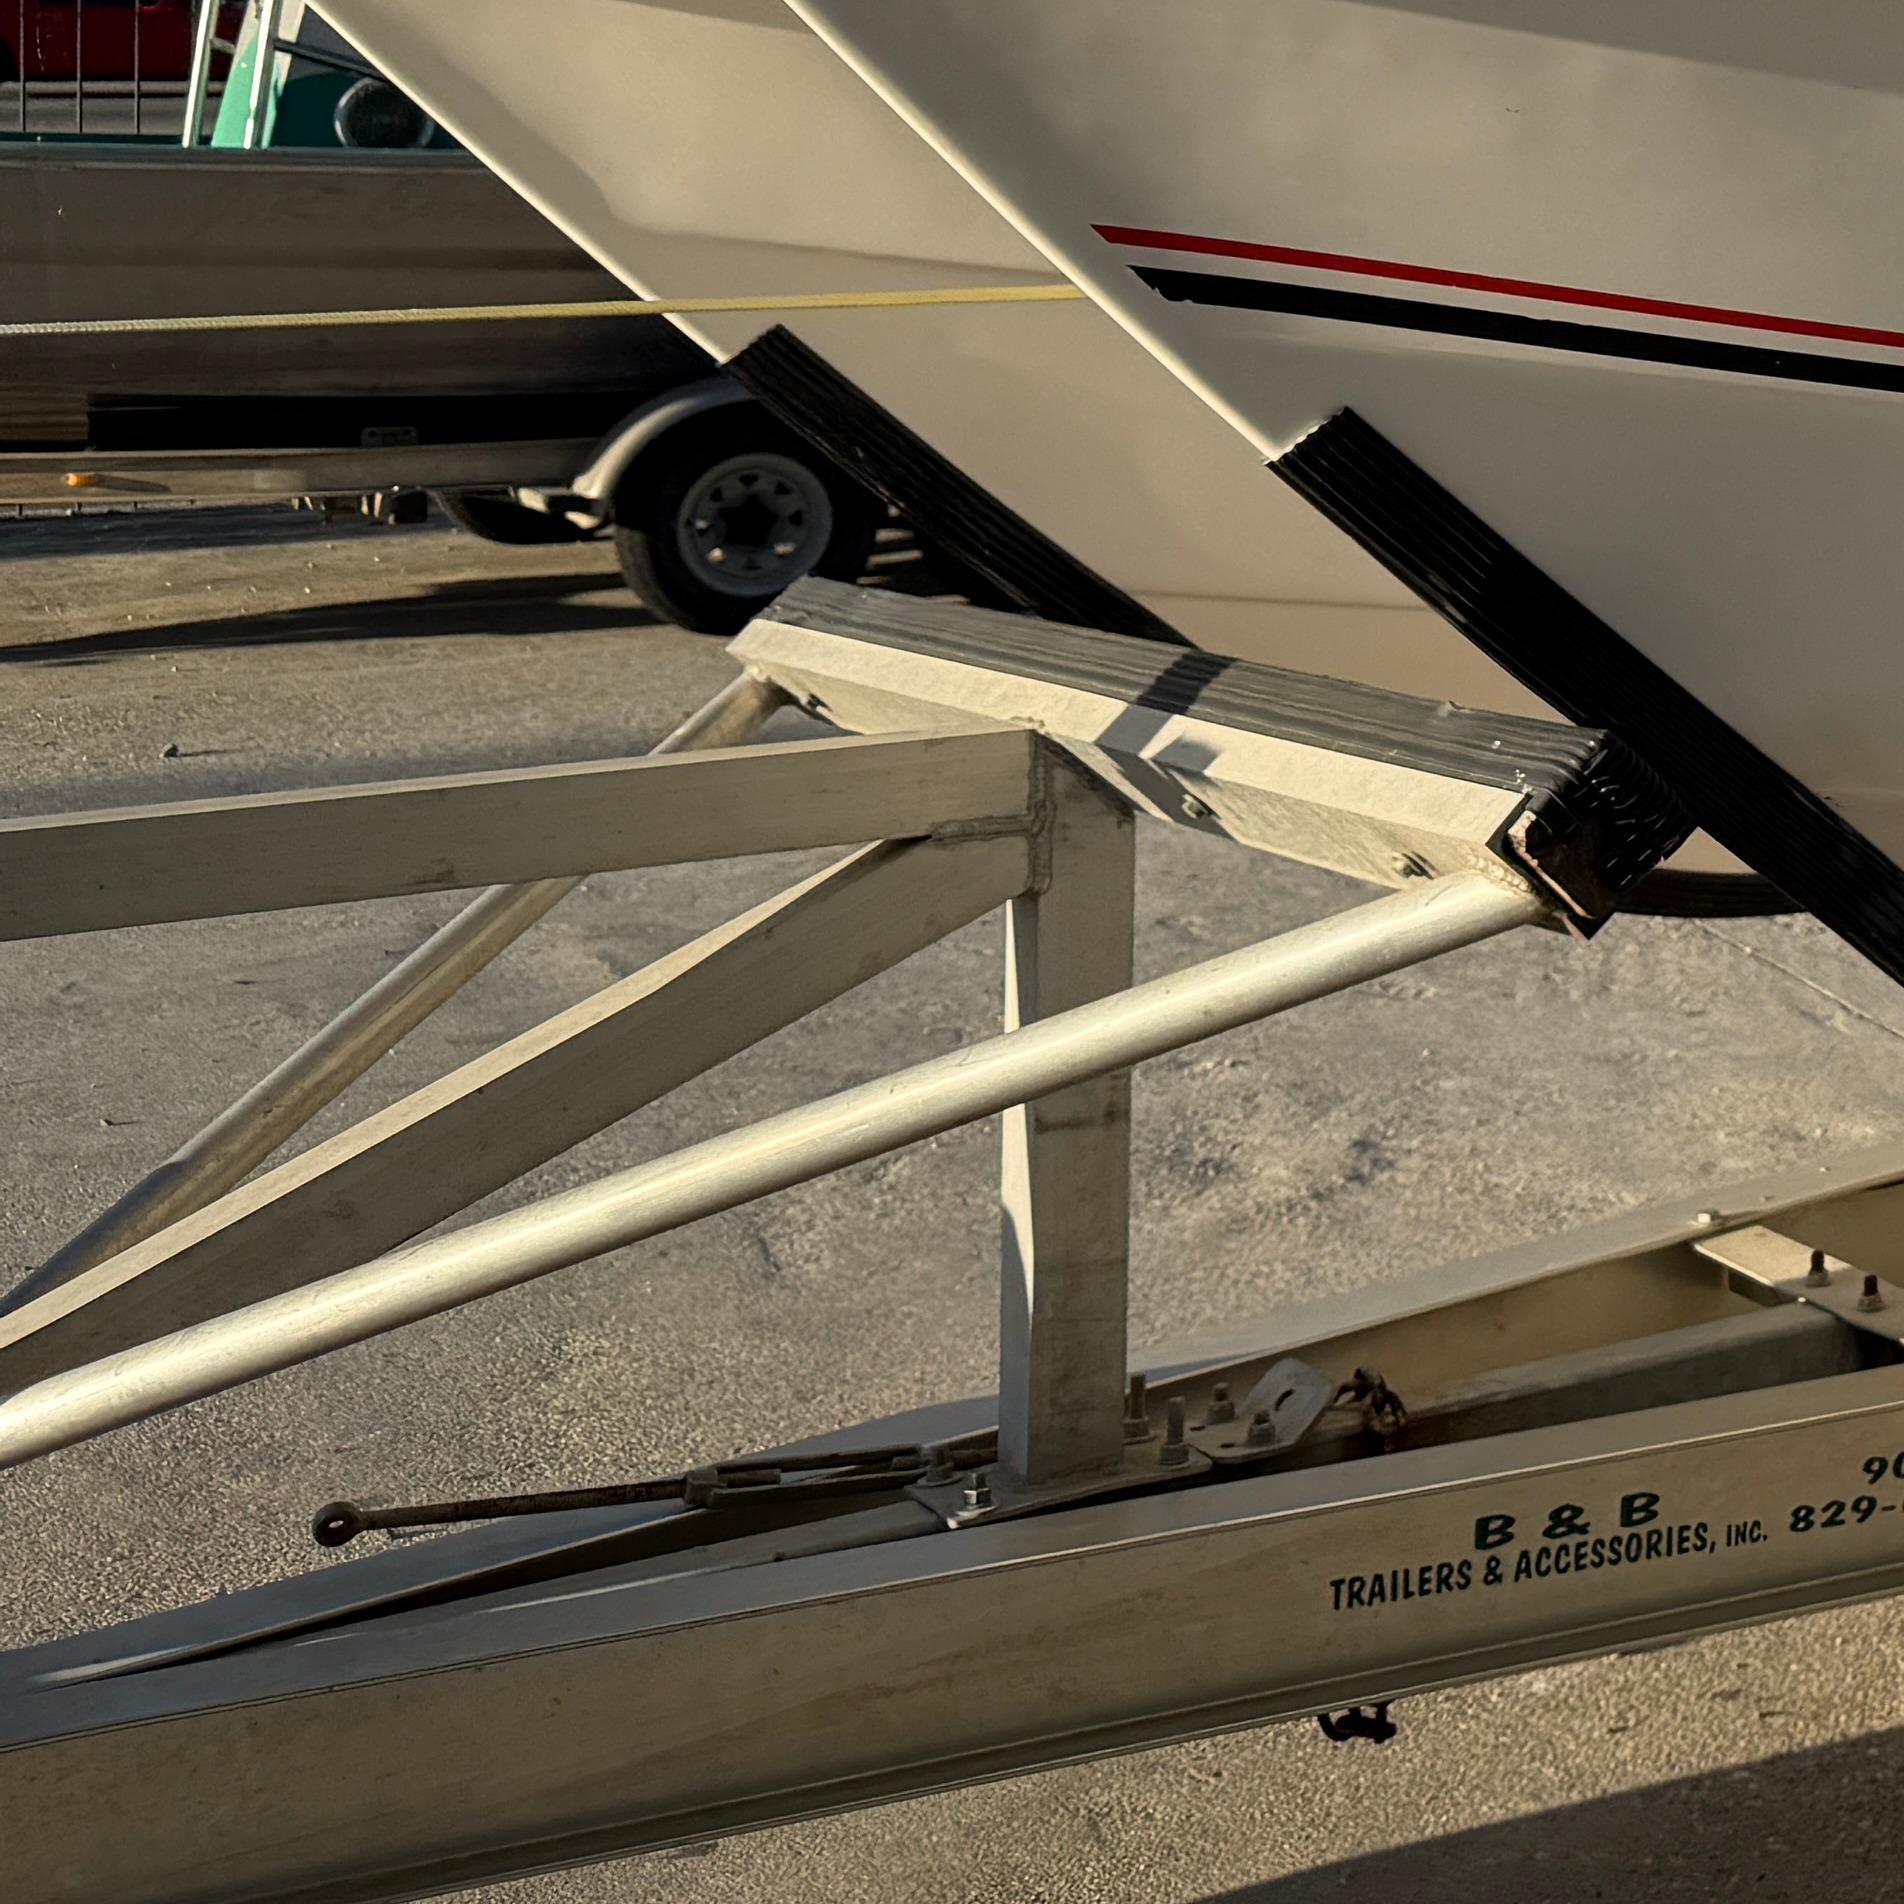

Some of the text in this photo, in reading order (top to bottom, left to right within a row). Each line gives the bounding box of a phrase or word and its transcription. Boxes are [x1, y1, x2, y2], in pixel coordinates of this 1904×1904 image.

[1474, 1491, 1663, 1551] B & B
[1330, 1520, 1769, 1611] TRAILERS & ACCESSORIES, INC.
